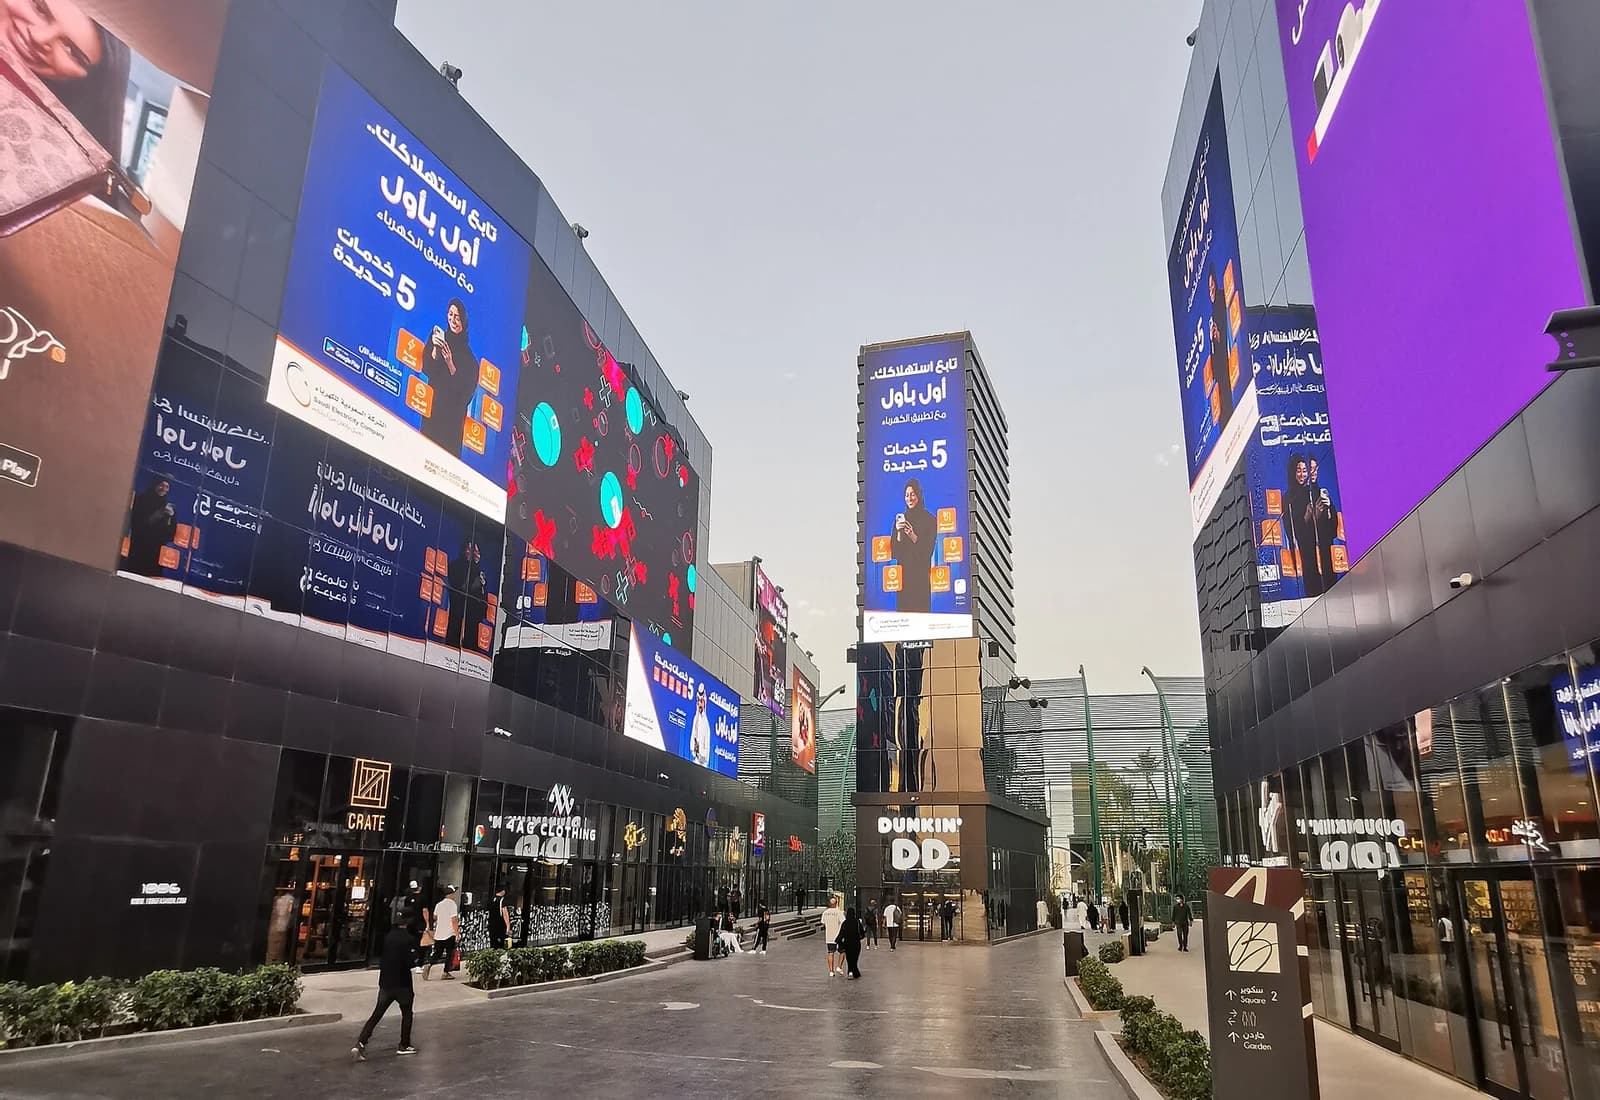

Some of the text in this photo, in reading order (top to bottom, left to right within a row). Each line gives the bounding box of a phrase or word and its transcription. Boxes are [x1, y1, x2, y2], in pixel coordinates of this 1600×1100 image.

[380, 175, 480, 267] أول بأول
[467, 209, 497, 242] تابع
[337, 226, 394, 278] خدمات
[376, 210, 474, 293] مع تطبيق الكهرباء
[332, 243, 392, 297] جديدة
[396, 273, 417, 311] 5
[935, 357, 958, 374] تابع
[881, 376, 947, 410] أول بأول
[313, 396, 331, 411] Saudi
[331, 406, 359, 426] Electricity
[360, 422, 385, 441] Company
[881, 409, 947, 426] مع تطبيق الكهرباء
[883, 439, 927, 455] خدمات
[931, 439, 948, 468] 5
[2, 458, 31, 480] Play
[883, 458, 927, 472] جديدة
[347, 812, 385, 832] CRATE
[541, 822, 596, 841] CLOTHING
[877, 816, 963, 834] DUNKIN'
[892, 838, 950, 871] DD
[1240, 995, 1267, 1005] Square
[1270, 989, 1278, 1001] 2
[1243, 1041, 1272, 1051] Garden
